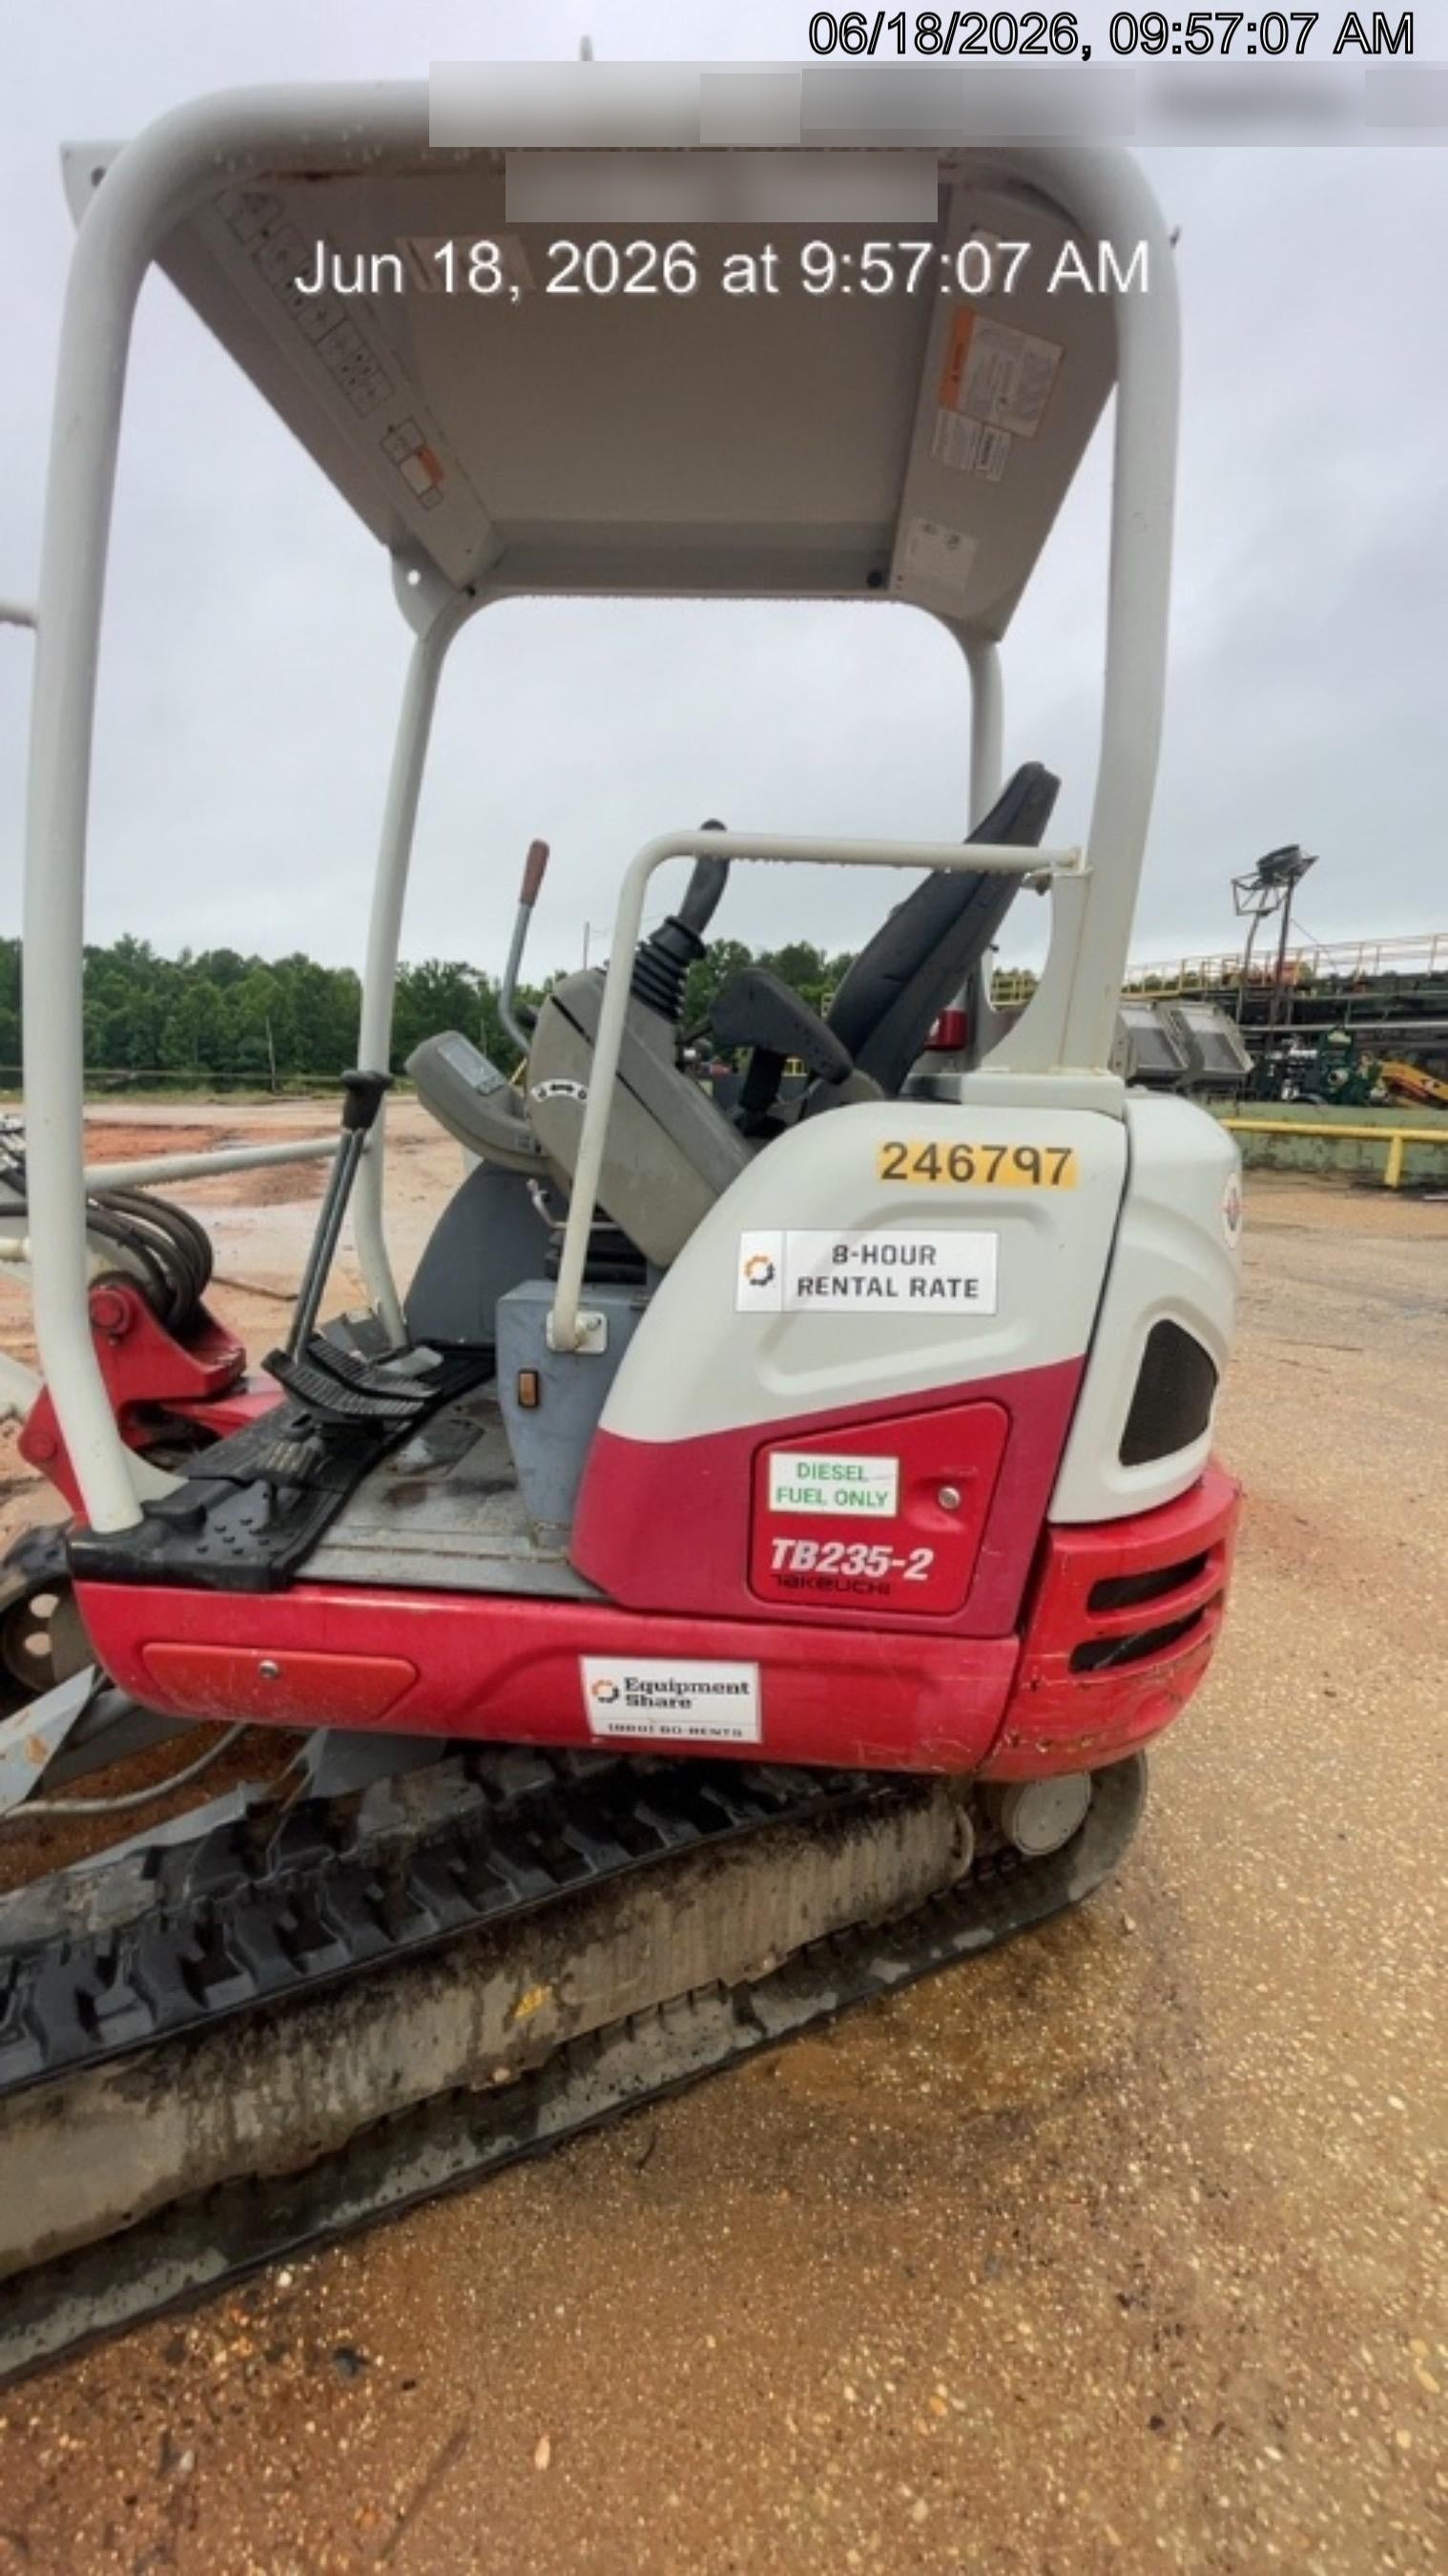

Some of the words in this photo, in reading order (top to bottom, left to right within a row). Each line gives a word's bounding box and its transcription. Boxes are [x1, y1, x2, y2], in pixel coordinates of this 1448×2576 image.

[880, 1141, 1074, 1186] 246797
[831, 1244, 938, 1266] 8-HOUR
[796, 1276, 899, 1298] RENTAL
[908, 1278, 980, 1299] RATE
[796, 1462, 869, 1482] DIESEL
[776, 1486, 826, 1505] FUEL
[835, 1489, 889, 1507] ONLY
[771, 1537, 935, 1581] TB235-2
[624, 1676, 750, 1695] Equipment
[626, 1693, 693, 1709] Share
